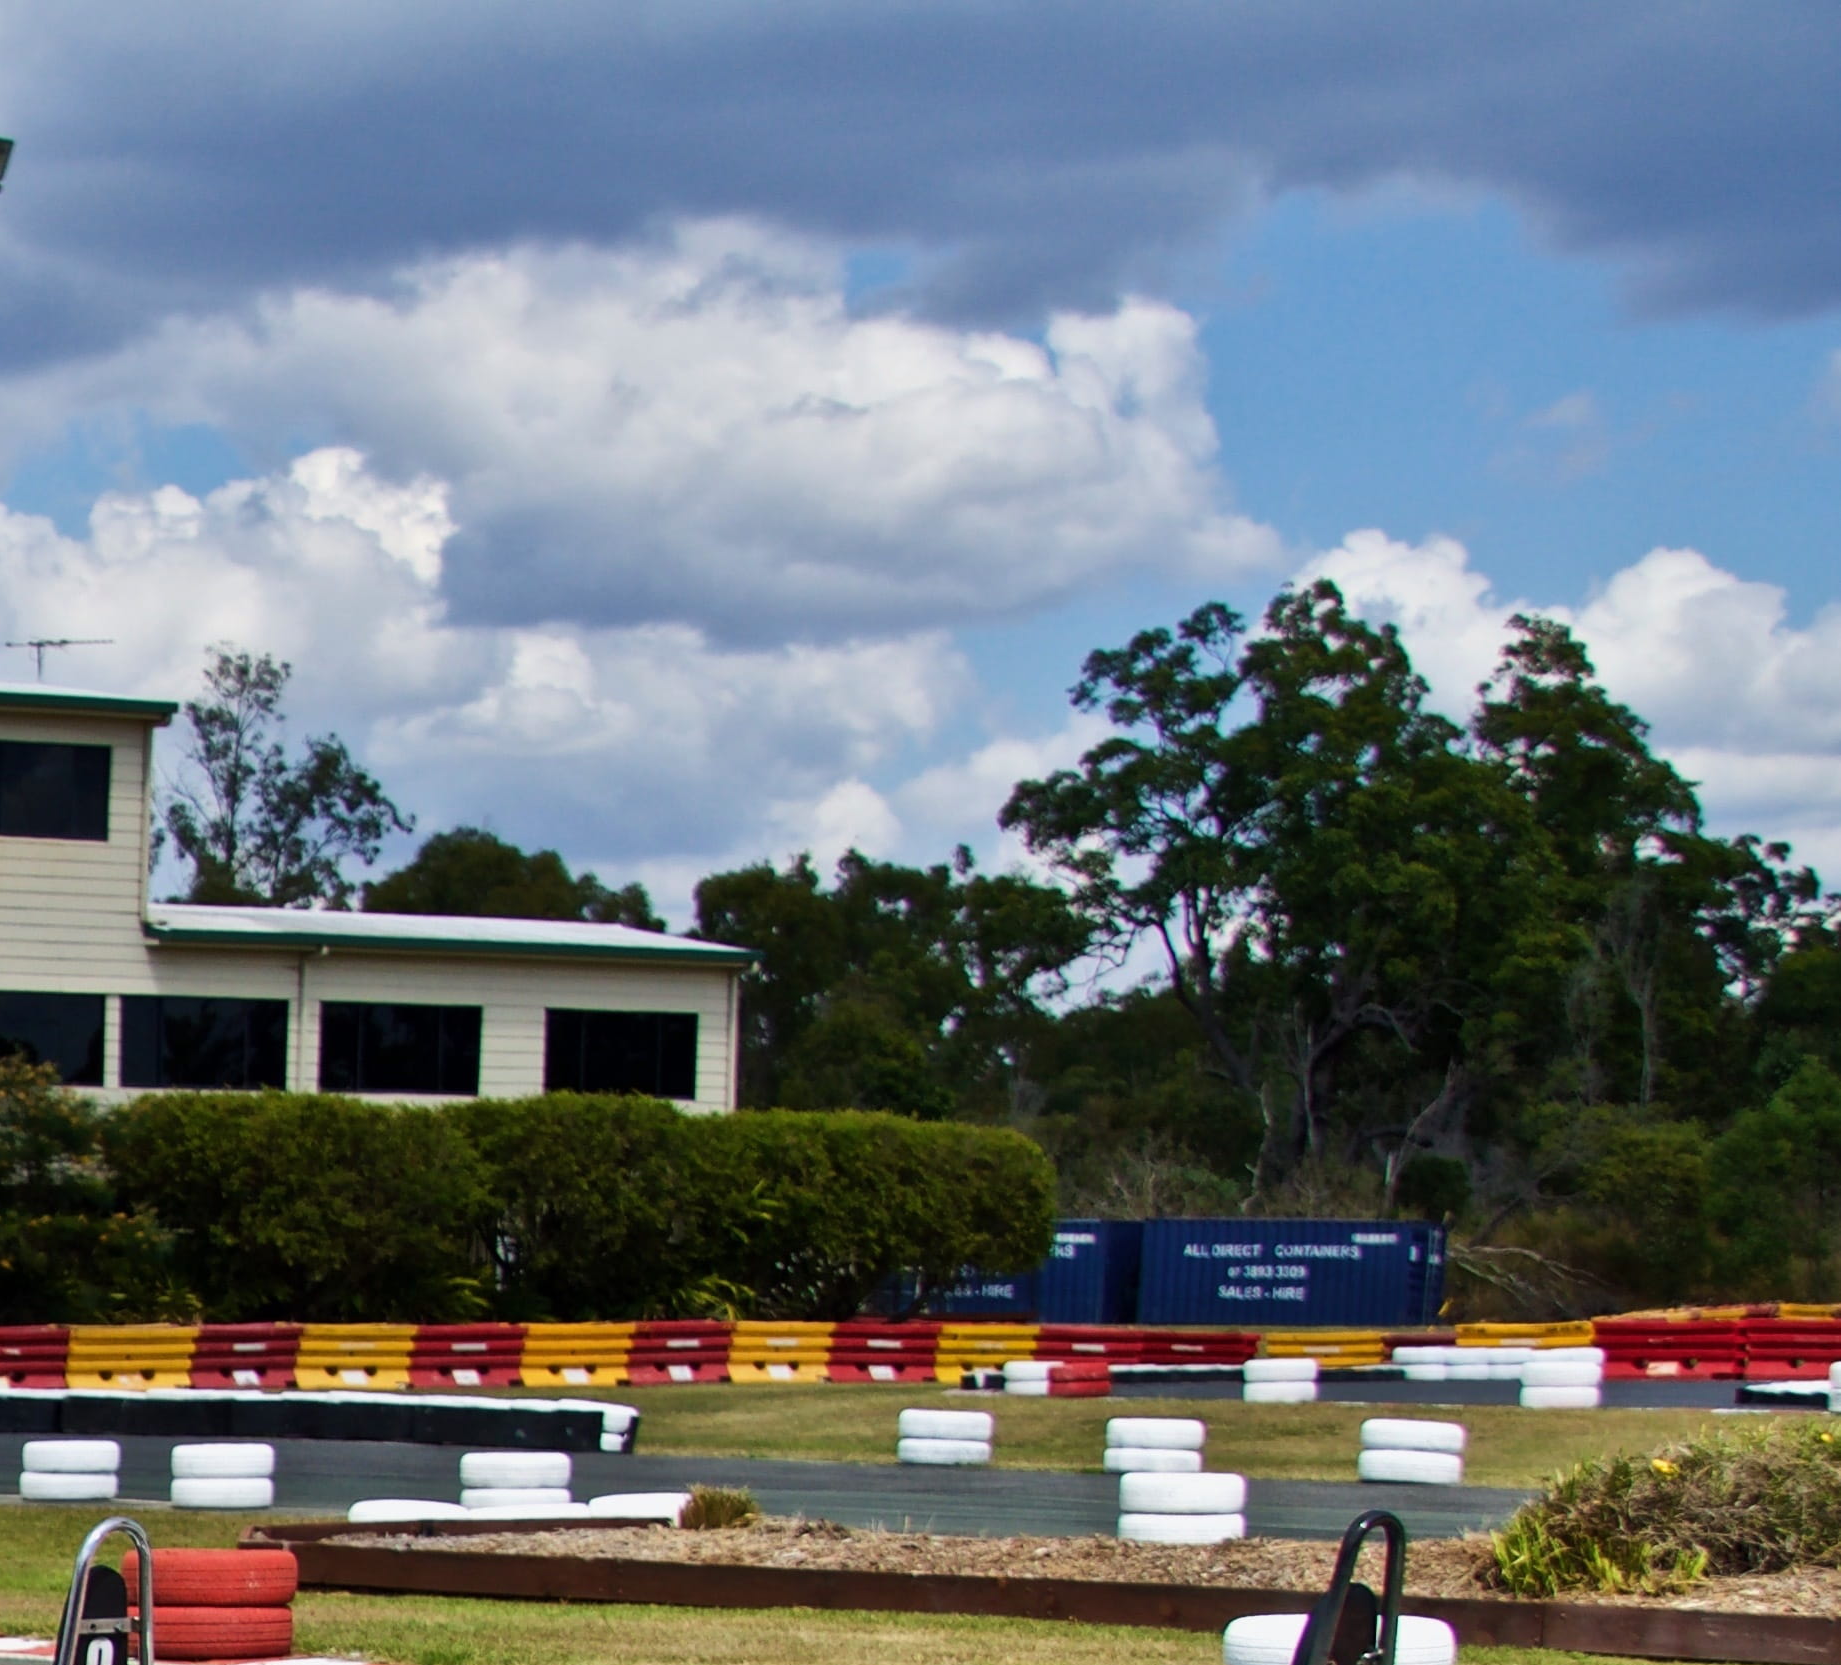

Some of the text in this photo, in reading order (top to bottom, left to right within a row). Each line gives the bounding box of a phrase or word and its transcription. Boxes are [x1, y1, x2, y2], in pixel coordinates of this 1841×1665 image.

[1211, 1243, 1262, 1258] DIRECT
[1274, 1244, 1361, 1259] CONTAINERS
[1218, 1284, 1261, 1299] SALES
[1272, 1286, 1305, 1301] HIRE
